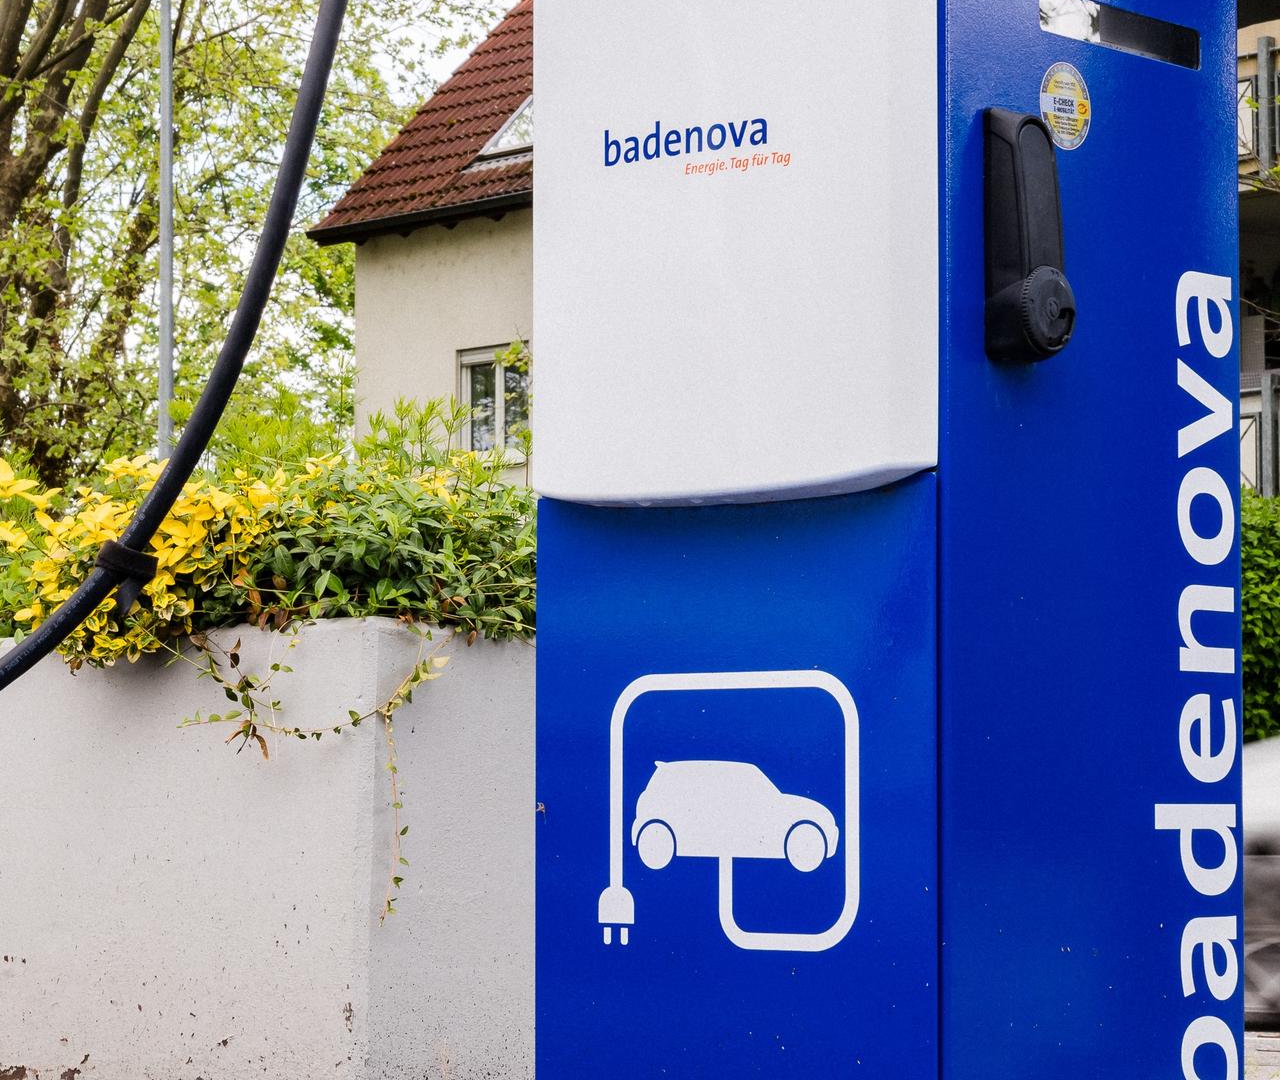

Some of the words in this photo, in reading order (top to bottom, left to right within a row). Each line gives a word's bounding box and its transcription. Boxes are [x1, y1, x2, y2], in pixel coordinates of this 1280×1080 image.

[604, 118, 768, 167] badenova
[685, 159, 728, 176] Energie.
[730, 157, 749, 172] Tag
[752, 153, 769, 167] für
[771, 152, 791, 167] Tag
